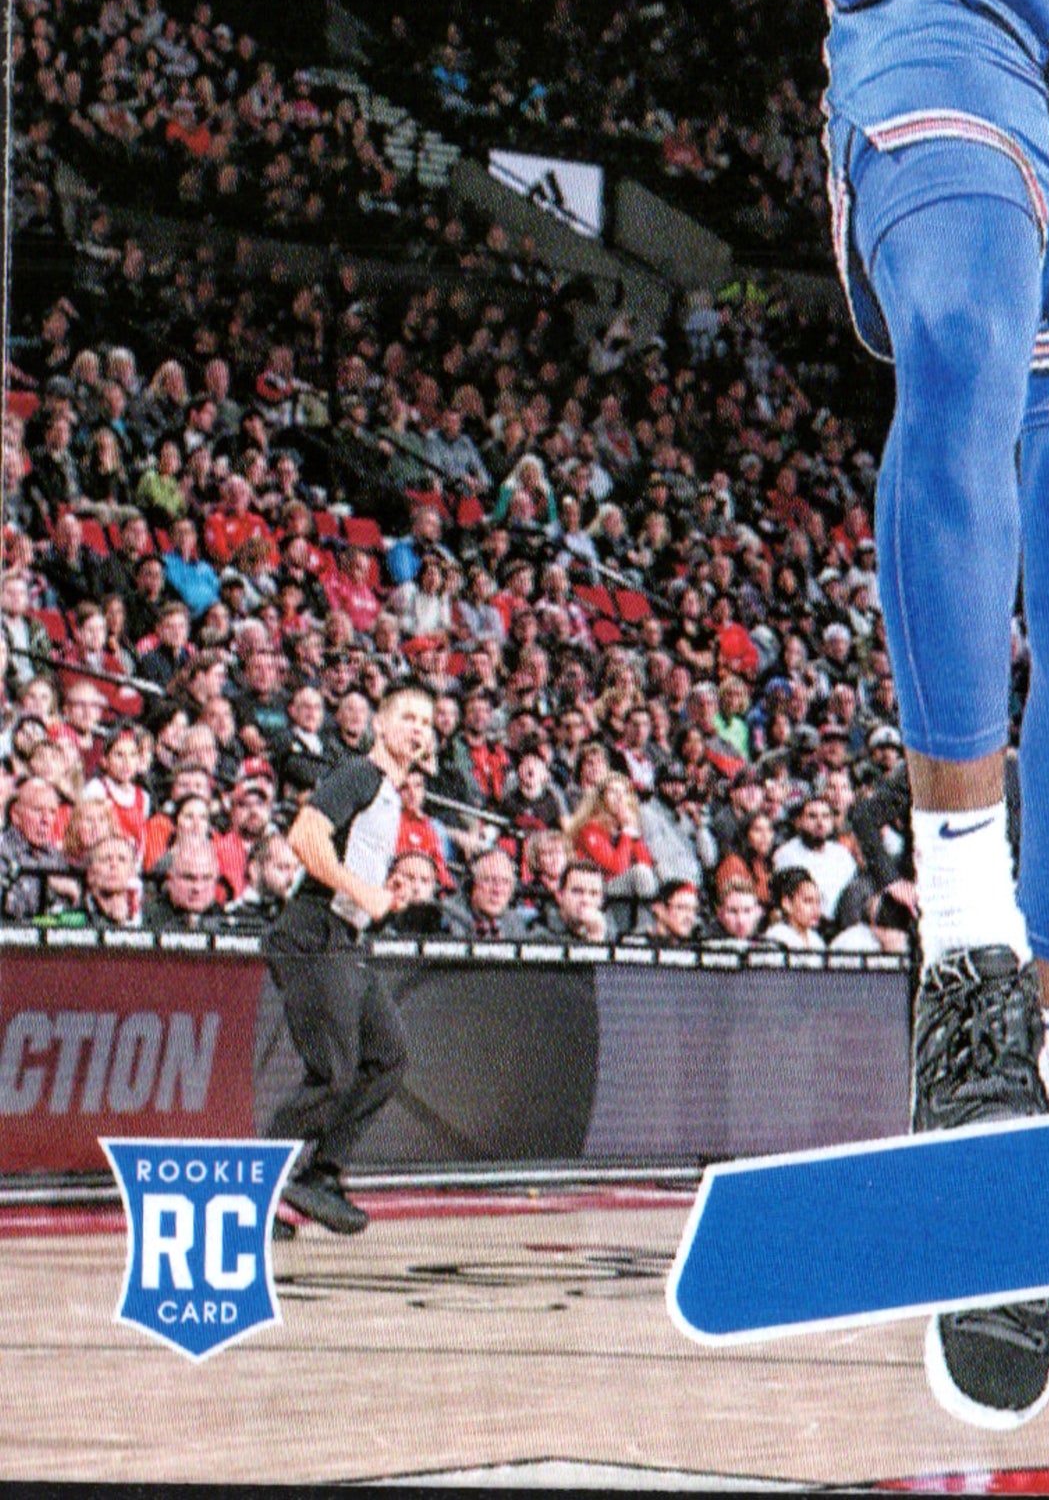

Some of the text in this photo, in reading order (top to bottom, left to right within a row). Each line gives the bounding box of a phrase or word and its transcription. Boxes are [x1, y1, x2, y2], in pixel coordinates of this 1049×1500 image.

[0, 1010, 222, 1114] CTION
[136, 1158, 264, 1184] ROOKIE
[141, 1192, 257, 1290] RC
[157, 1301, 238, 1324] CARD
